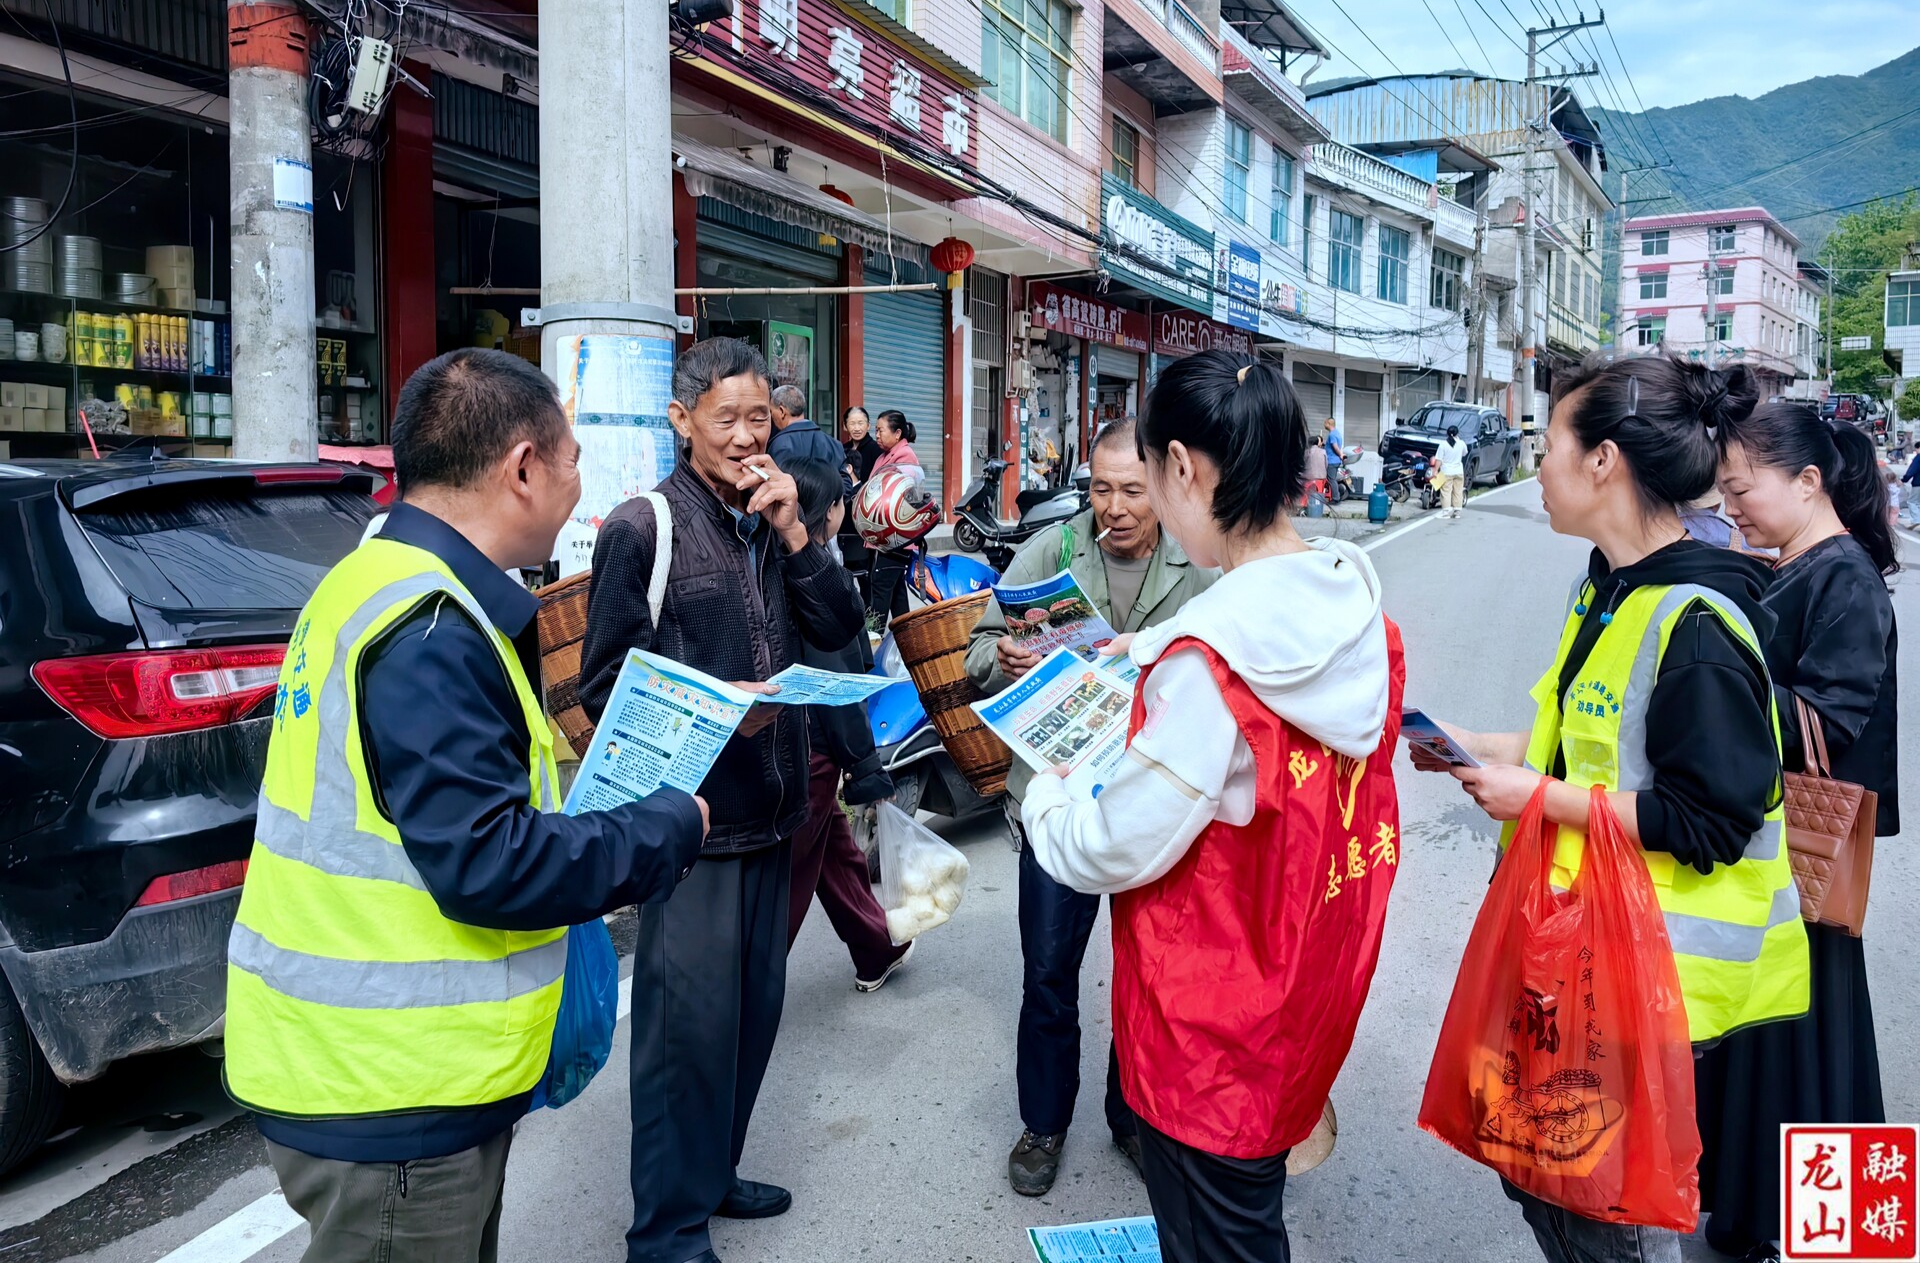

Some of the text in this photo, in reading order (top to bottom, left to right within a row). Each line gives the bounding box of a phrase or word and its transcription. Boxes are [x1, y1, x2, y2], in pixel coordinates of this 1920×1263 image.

[758, 0, 970, 156] 明亮超市
[1162, 314, 1197, 349] CARE
[1324, 821, 1397, 905] 志愿者
